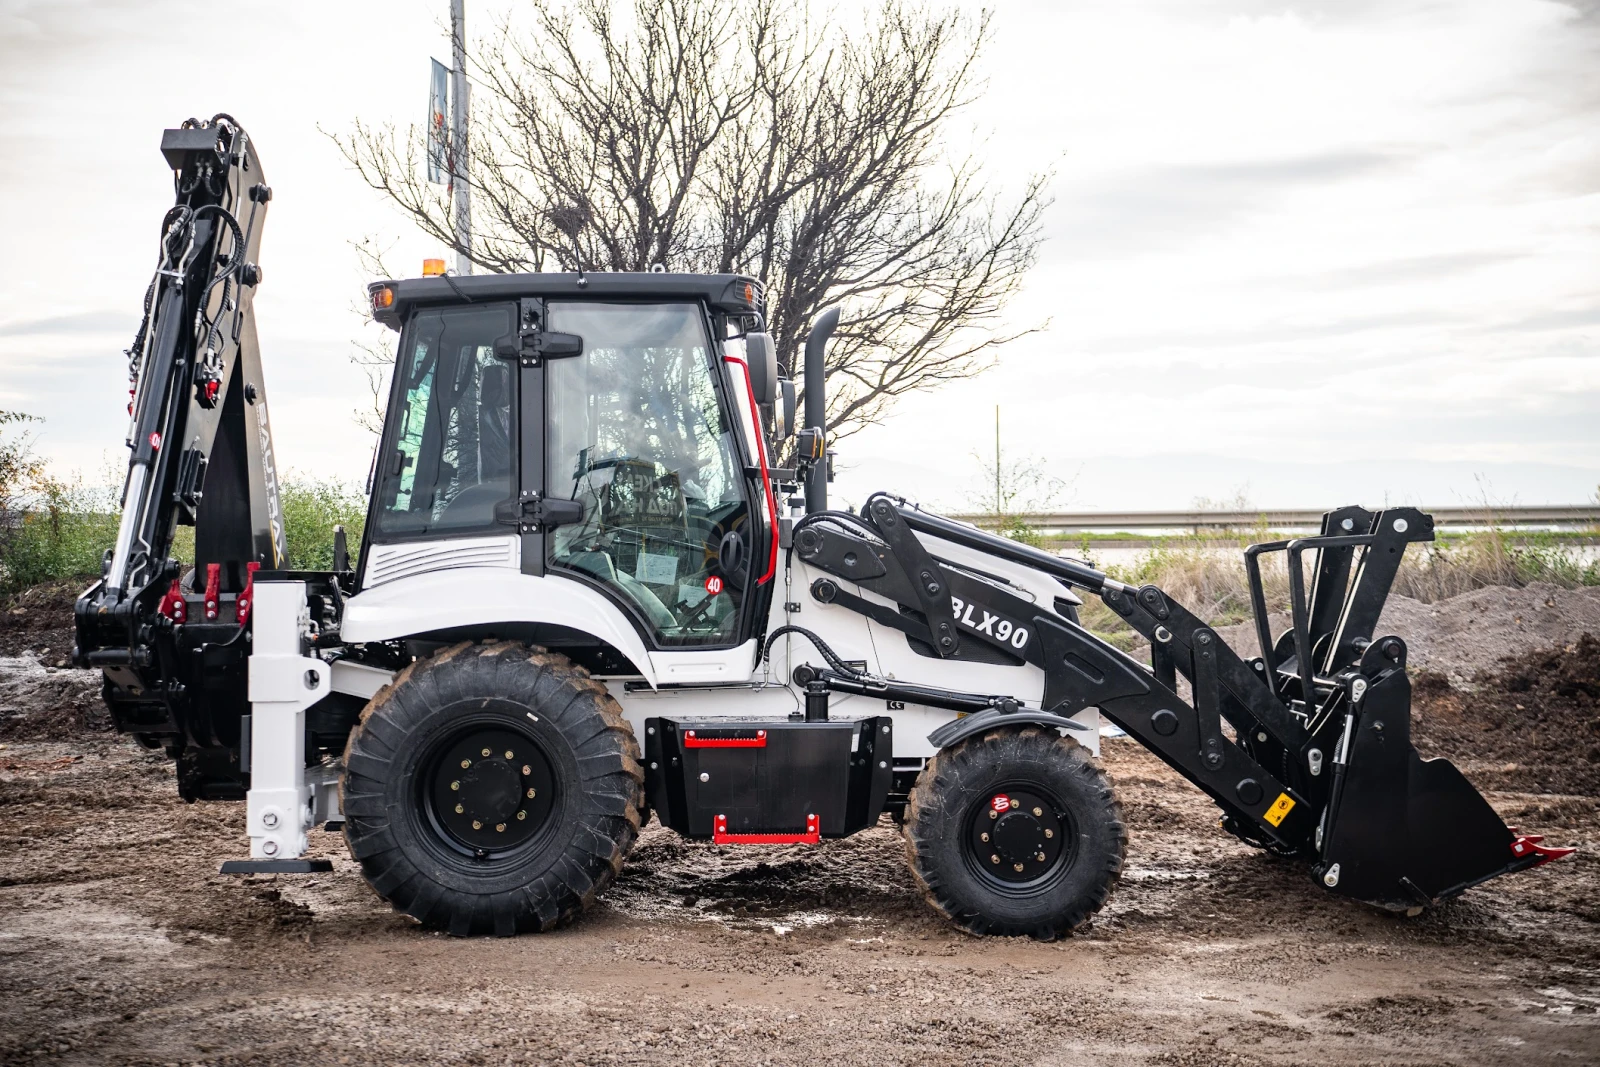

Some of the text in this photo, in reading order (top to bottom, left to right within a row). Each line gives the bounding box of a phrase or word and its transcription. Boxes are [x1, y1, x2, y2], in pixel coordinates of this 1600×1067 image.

[259, 402, 284, 567] BAUTRAX
[707, 577, 721, 593] 40
[951, 595, 1029, 649] BLX90
[992, 796, 1010, 811] 40
